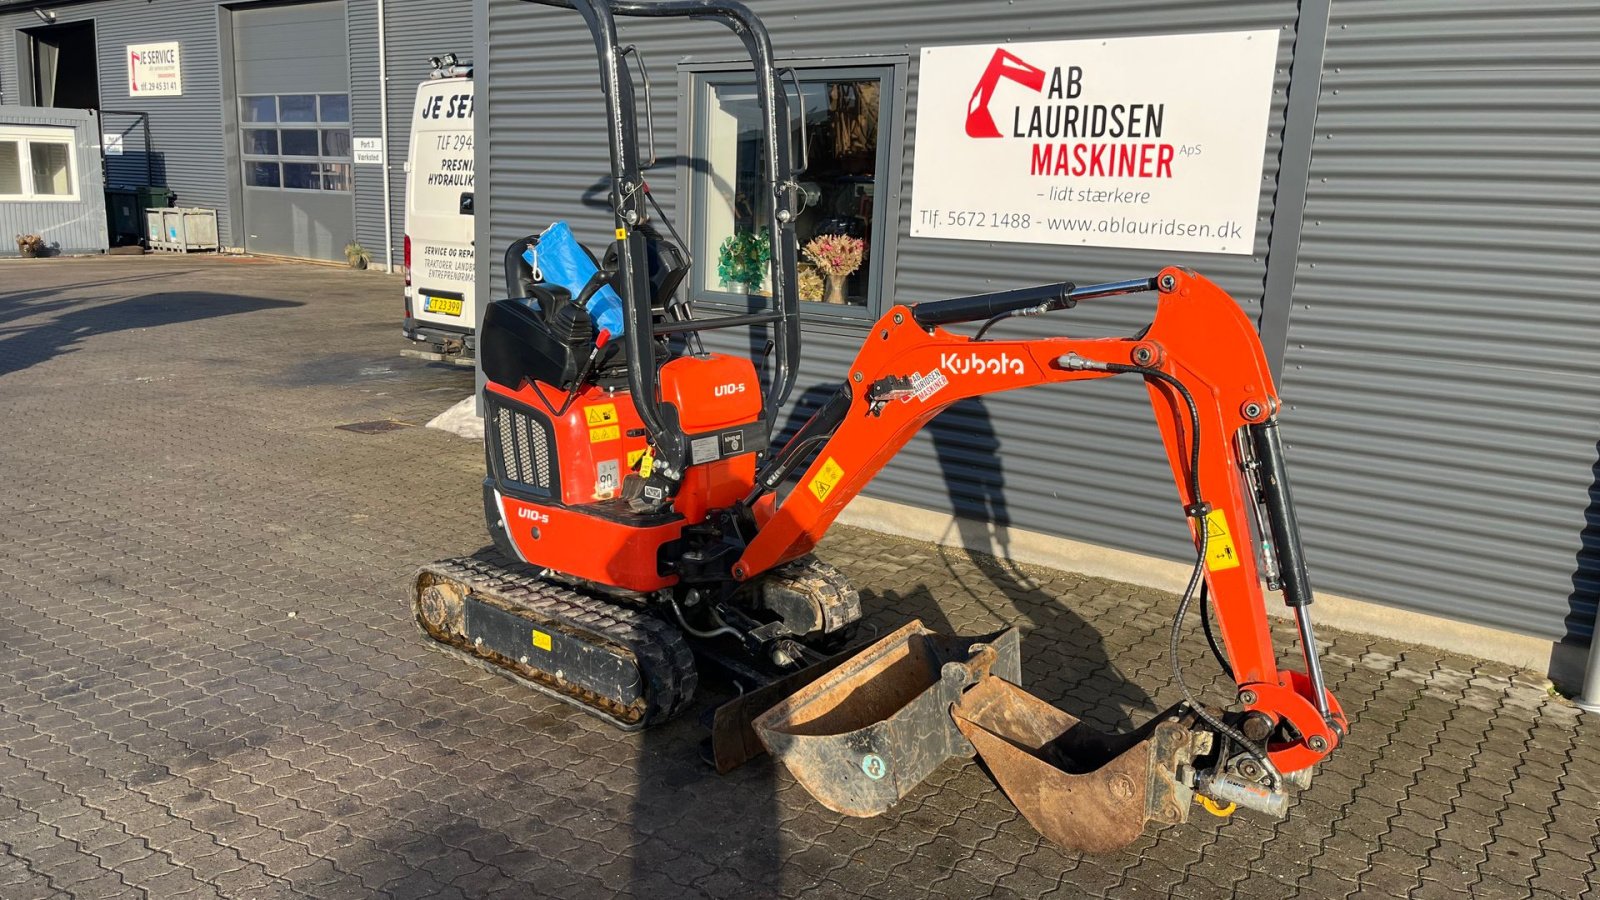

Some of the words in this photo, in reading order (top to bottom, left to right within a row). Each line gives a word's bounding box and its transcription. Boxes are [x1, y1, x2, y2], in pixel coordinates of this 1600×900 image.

[140, 51, 147, 65] JE
[147, 49, 175, 65] SERVICE
[149, 82, 155, 91] 29
[156, 82, 162, 91] 45
[163, 82, 169, 91] 31
[170, 81, 177, 91] 41
[1047, 65, 1083, 100] AB
[422, 95, 443, 119] JE
[1013, 103, 1164, 138] LAURIDSEN
[360, 140, 370, 149] Port
[437, 135, 451, 150] TLF
[453, 134, 474, 152] 294
[1030, 143, 1174, 178] MASKINER
[1179, 144, 1202, 158] ApS
[1049, 186, 1074, 202] lidt
[1078, 187, 1151, 204] stærkere
[920, 209, 942, 228] Tlf.
[948, 210, 986, 227] 5672
[990, 212, 1031, 229] 1488
[1047, 216, 1242, 239] www.ablauridsen.dk
[425, 246, 447, 257] SERVICE
[449, 248, 457, 257] OG
[430, 298, 438, 309] CT
[439, 299, 447, 310] 23
[448, 300, 460, 312] 399
[940, 353, 1025, 375] Kubota
[714, 383, 746, 397] U10-5
[917, 375, 947, 400] MASKINER
[517, 507, 550, 524] U10-5
